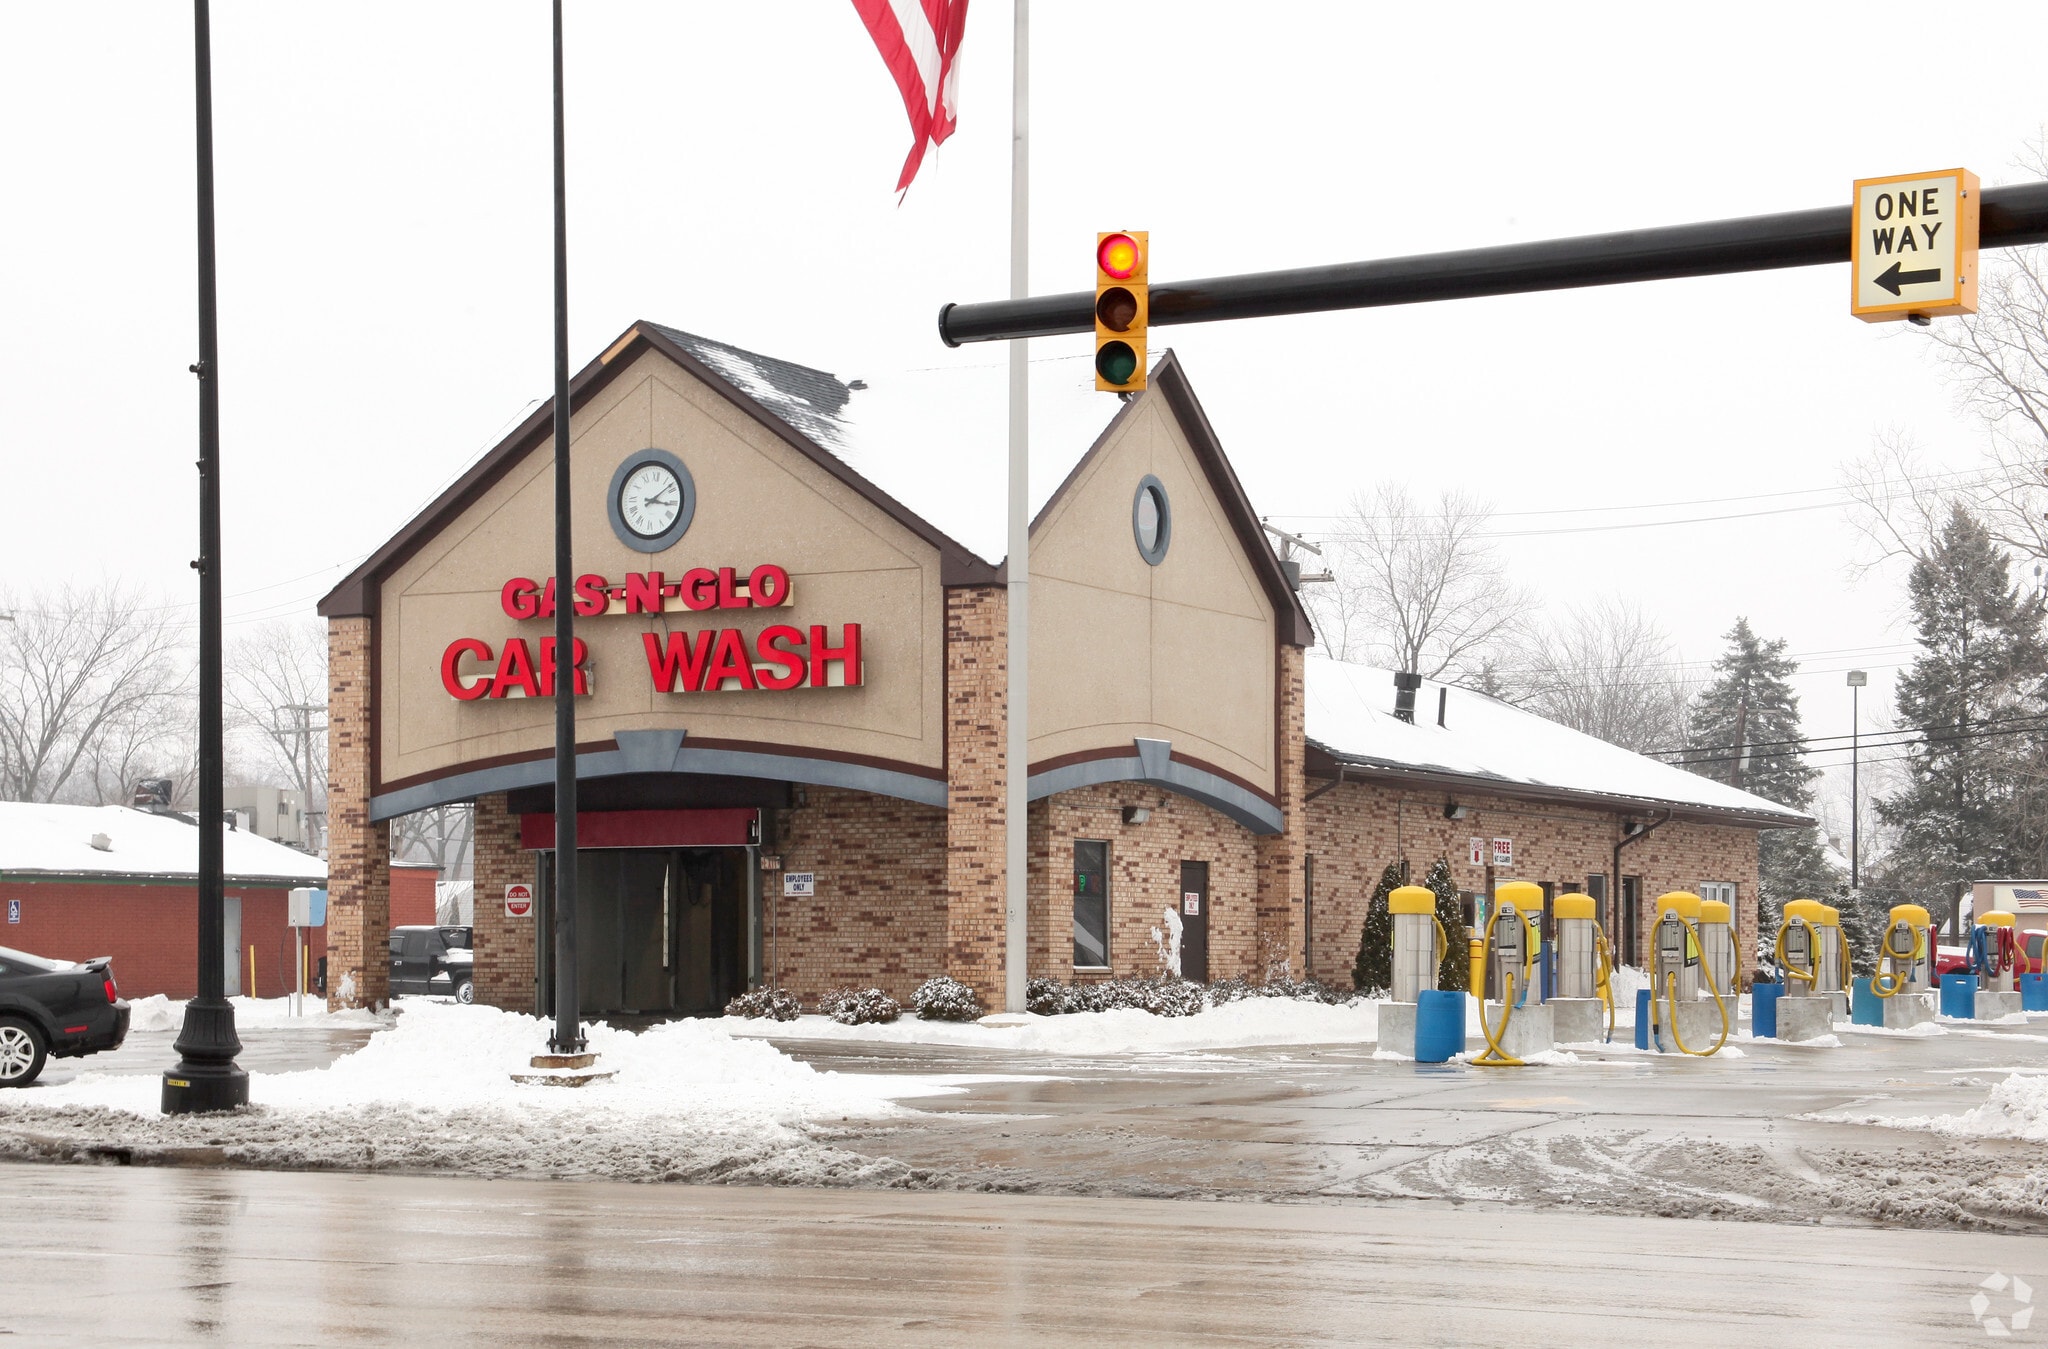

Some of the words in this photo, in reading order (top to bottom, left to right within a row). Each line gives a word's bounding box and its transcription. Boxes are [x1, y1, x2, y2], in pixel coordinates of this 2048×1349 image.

[1875, 188, 1939, 221] ONE
[1872, 222, 1942, 255] WAY
[441, 636, 588, 700] CAR
[641, 623, 861, 693] WASH
[1494, 840, 1511, 855] FREE
[785, 874, 813, 883] EMPLOYEES
[793, 883, 805, 891] ONLY
